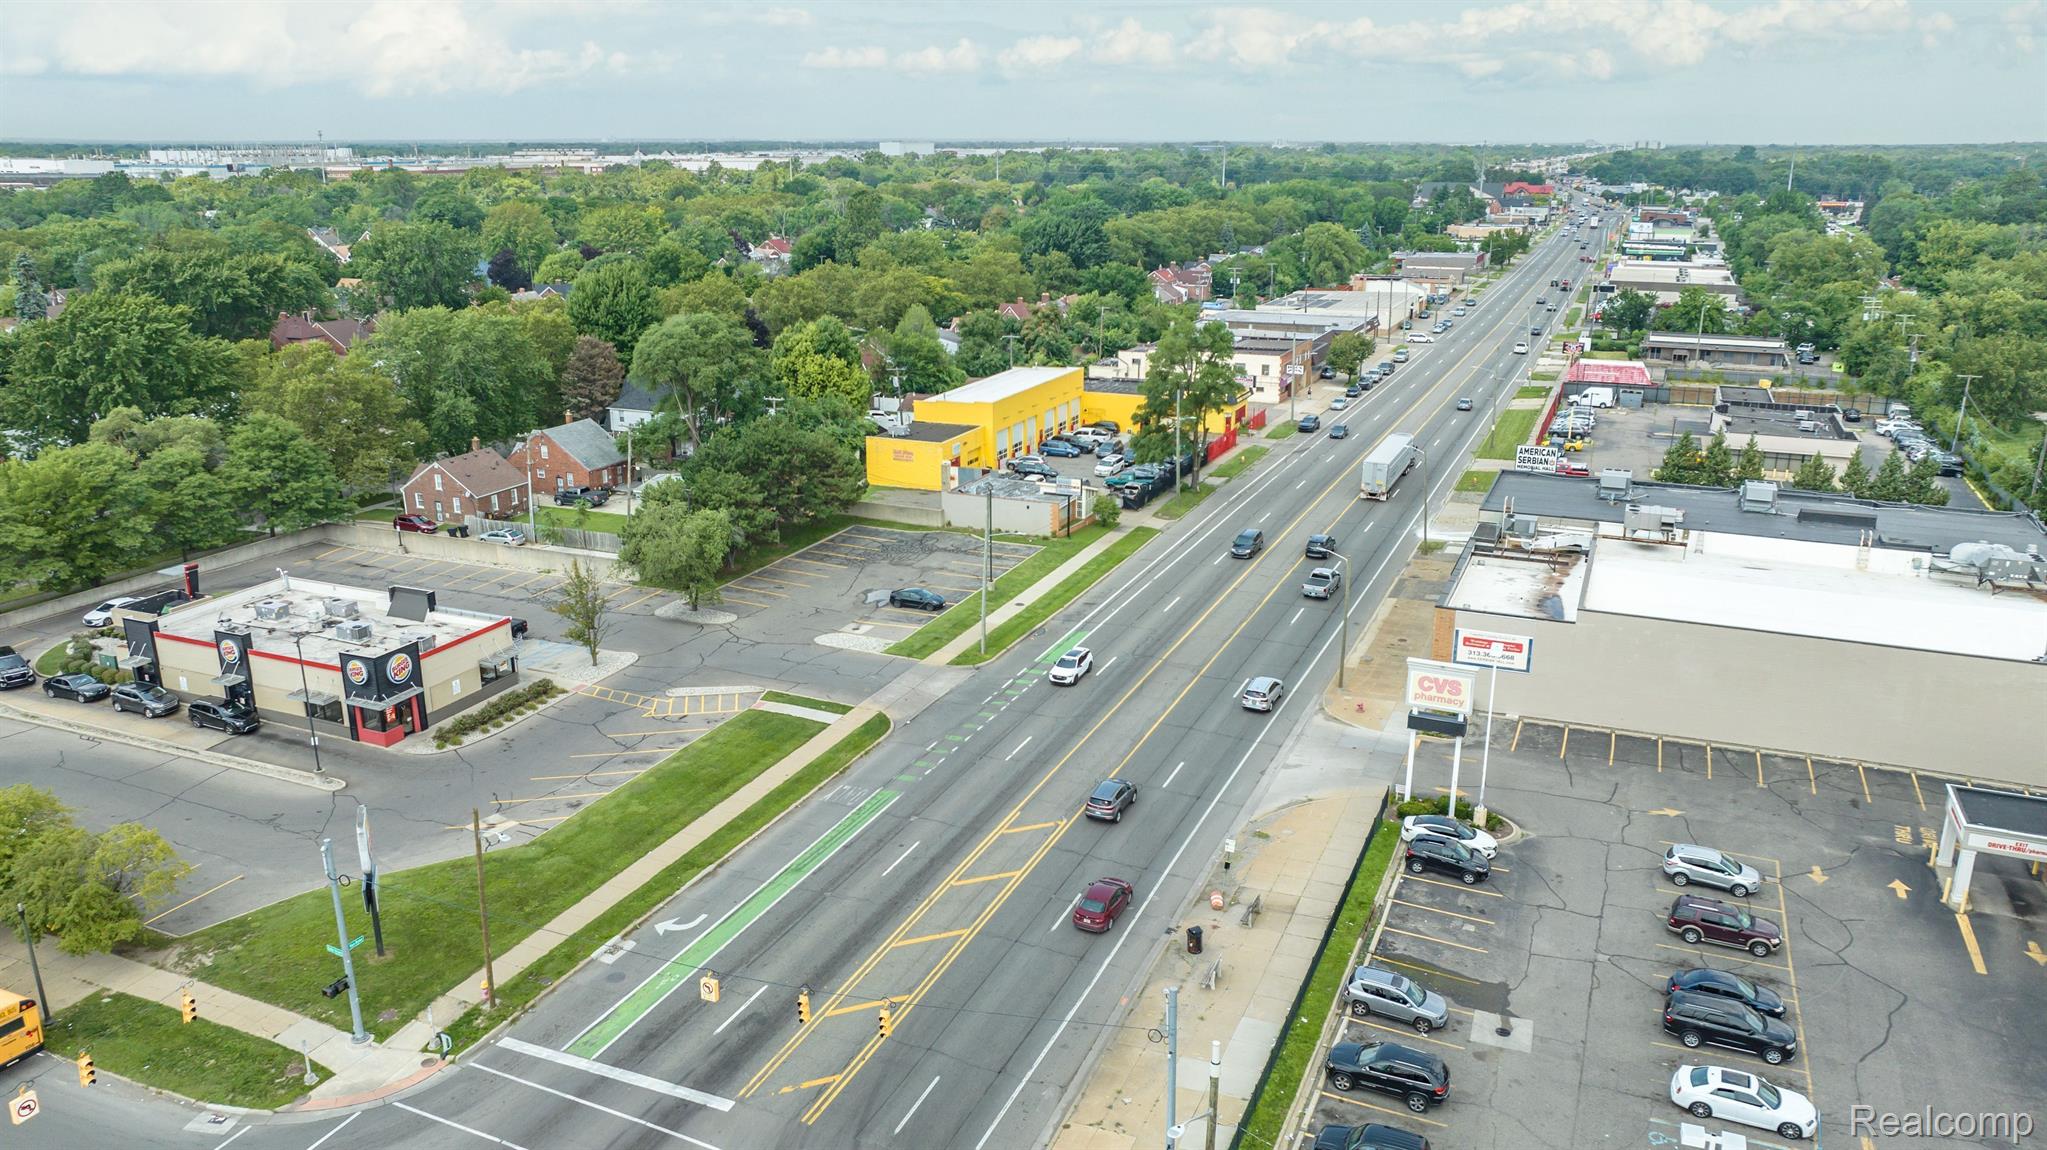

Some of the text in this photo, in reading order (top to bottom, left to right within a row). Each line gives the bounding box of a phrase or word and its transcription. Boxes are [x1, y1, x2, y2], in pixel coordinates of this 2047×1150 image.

[1519, 447, 1556, 457] AMERICAN
[1518, 455, 1549, 465] SERBIAN
[392, 657, 408, 672] BURGER
[393, 662, 410, 678] KING
[1418, 676, 1463, 697] CVS
[1414, 692, 1465, 707] pharmacy
